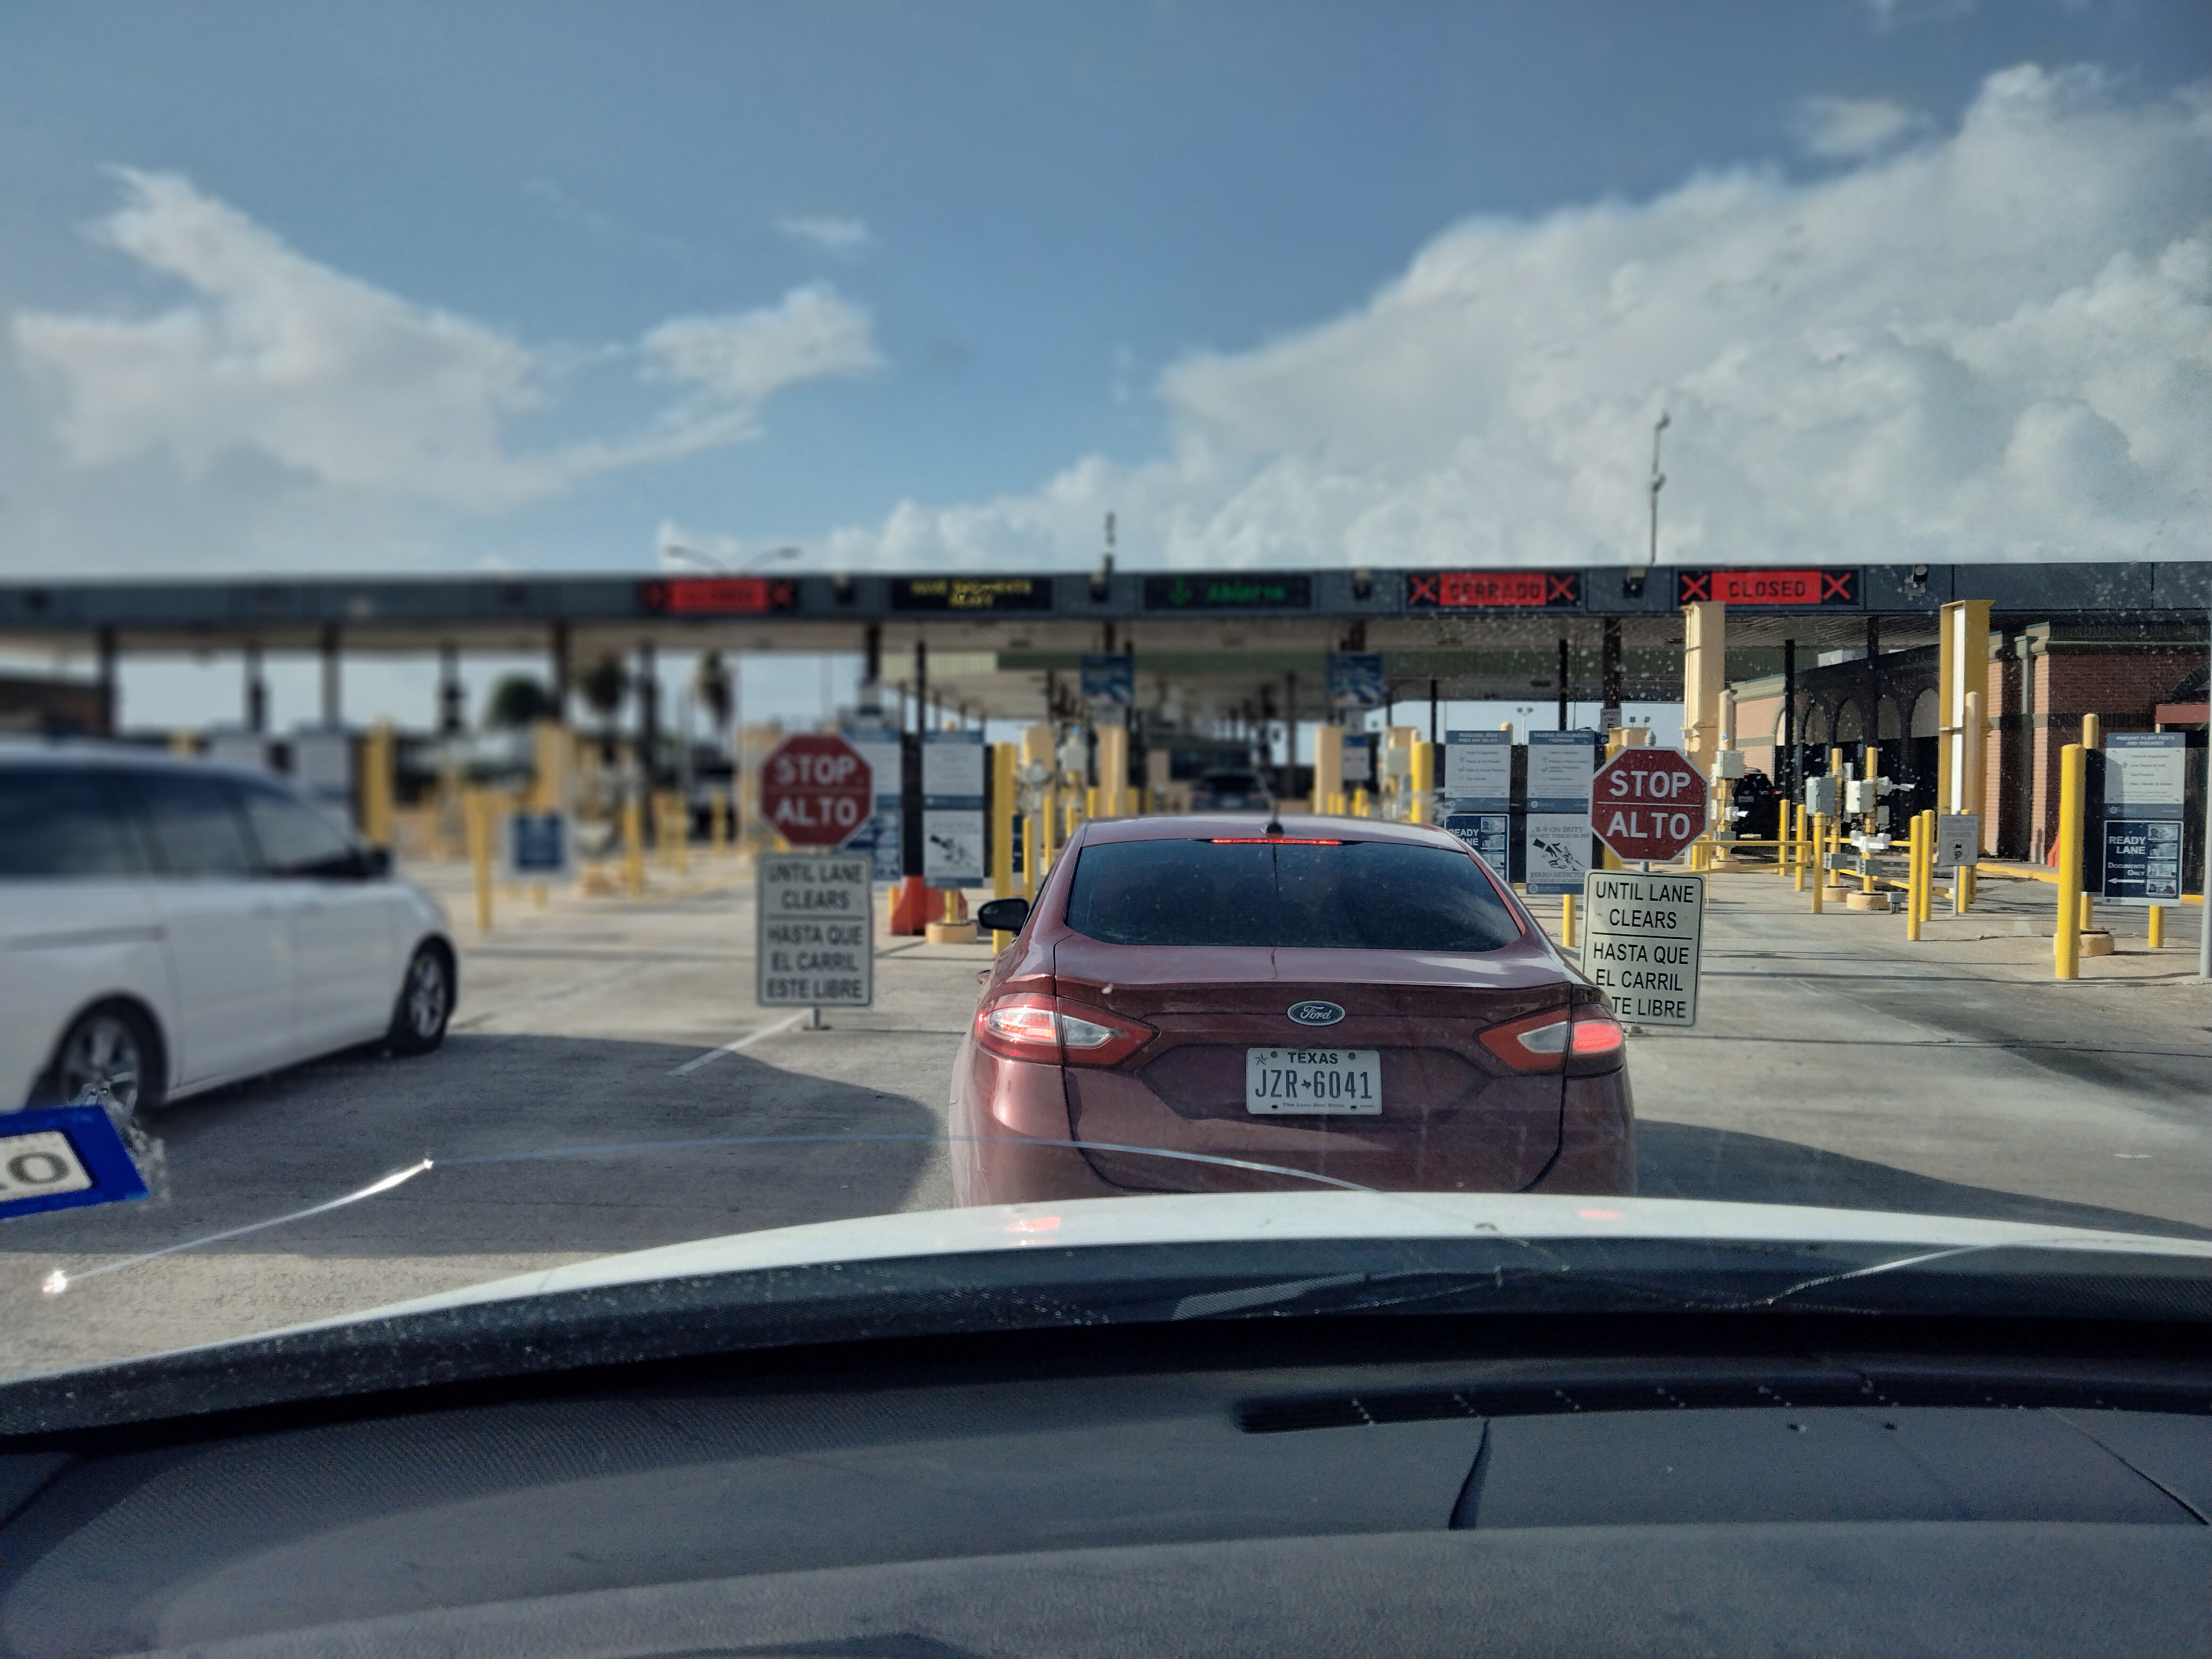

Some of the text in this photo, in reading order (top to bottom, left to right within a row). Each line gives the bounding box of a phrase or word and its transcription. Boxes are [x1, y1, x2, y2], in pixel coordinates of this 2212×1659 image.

[1450, 583, 1540, 599] CERRADO
[1730, 581, 1806, 597] CLOSED
[774, 755, 857, 784] STOP
[1608, 770, 1691, 798] STOP
[775, 798, 857, 827] ALTO
[1606, 811, 1691, 840] ALTO
[2108, 836, 2147, 845] READY
[2116, 846, 2146, 854] LANE
[819, 864, 863, 885] LANE
[781, 889, 850, 911] CLEARS
[1596, 881, 1694, 903] UNTIL LANE
[1610, 909, 1677, 929] CLEARS
[768, 925, 862, 946] HASTA QUE
[772, 951, 859, 973] EL CARRIL
[1593, 942, 1689, 965] HASTA QUE
[767, 978, 862, 999] ESTE LIBRE
[1596, 968, 1683, 991] EL CARRIL
[1300, 1006, 1333, 1019] Ford
[1612, 996, 1687, 1018] TE LIBRE
[1287, 1052, 1339, 1065] TEXAS
